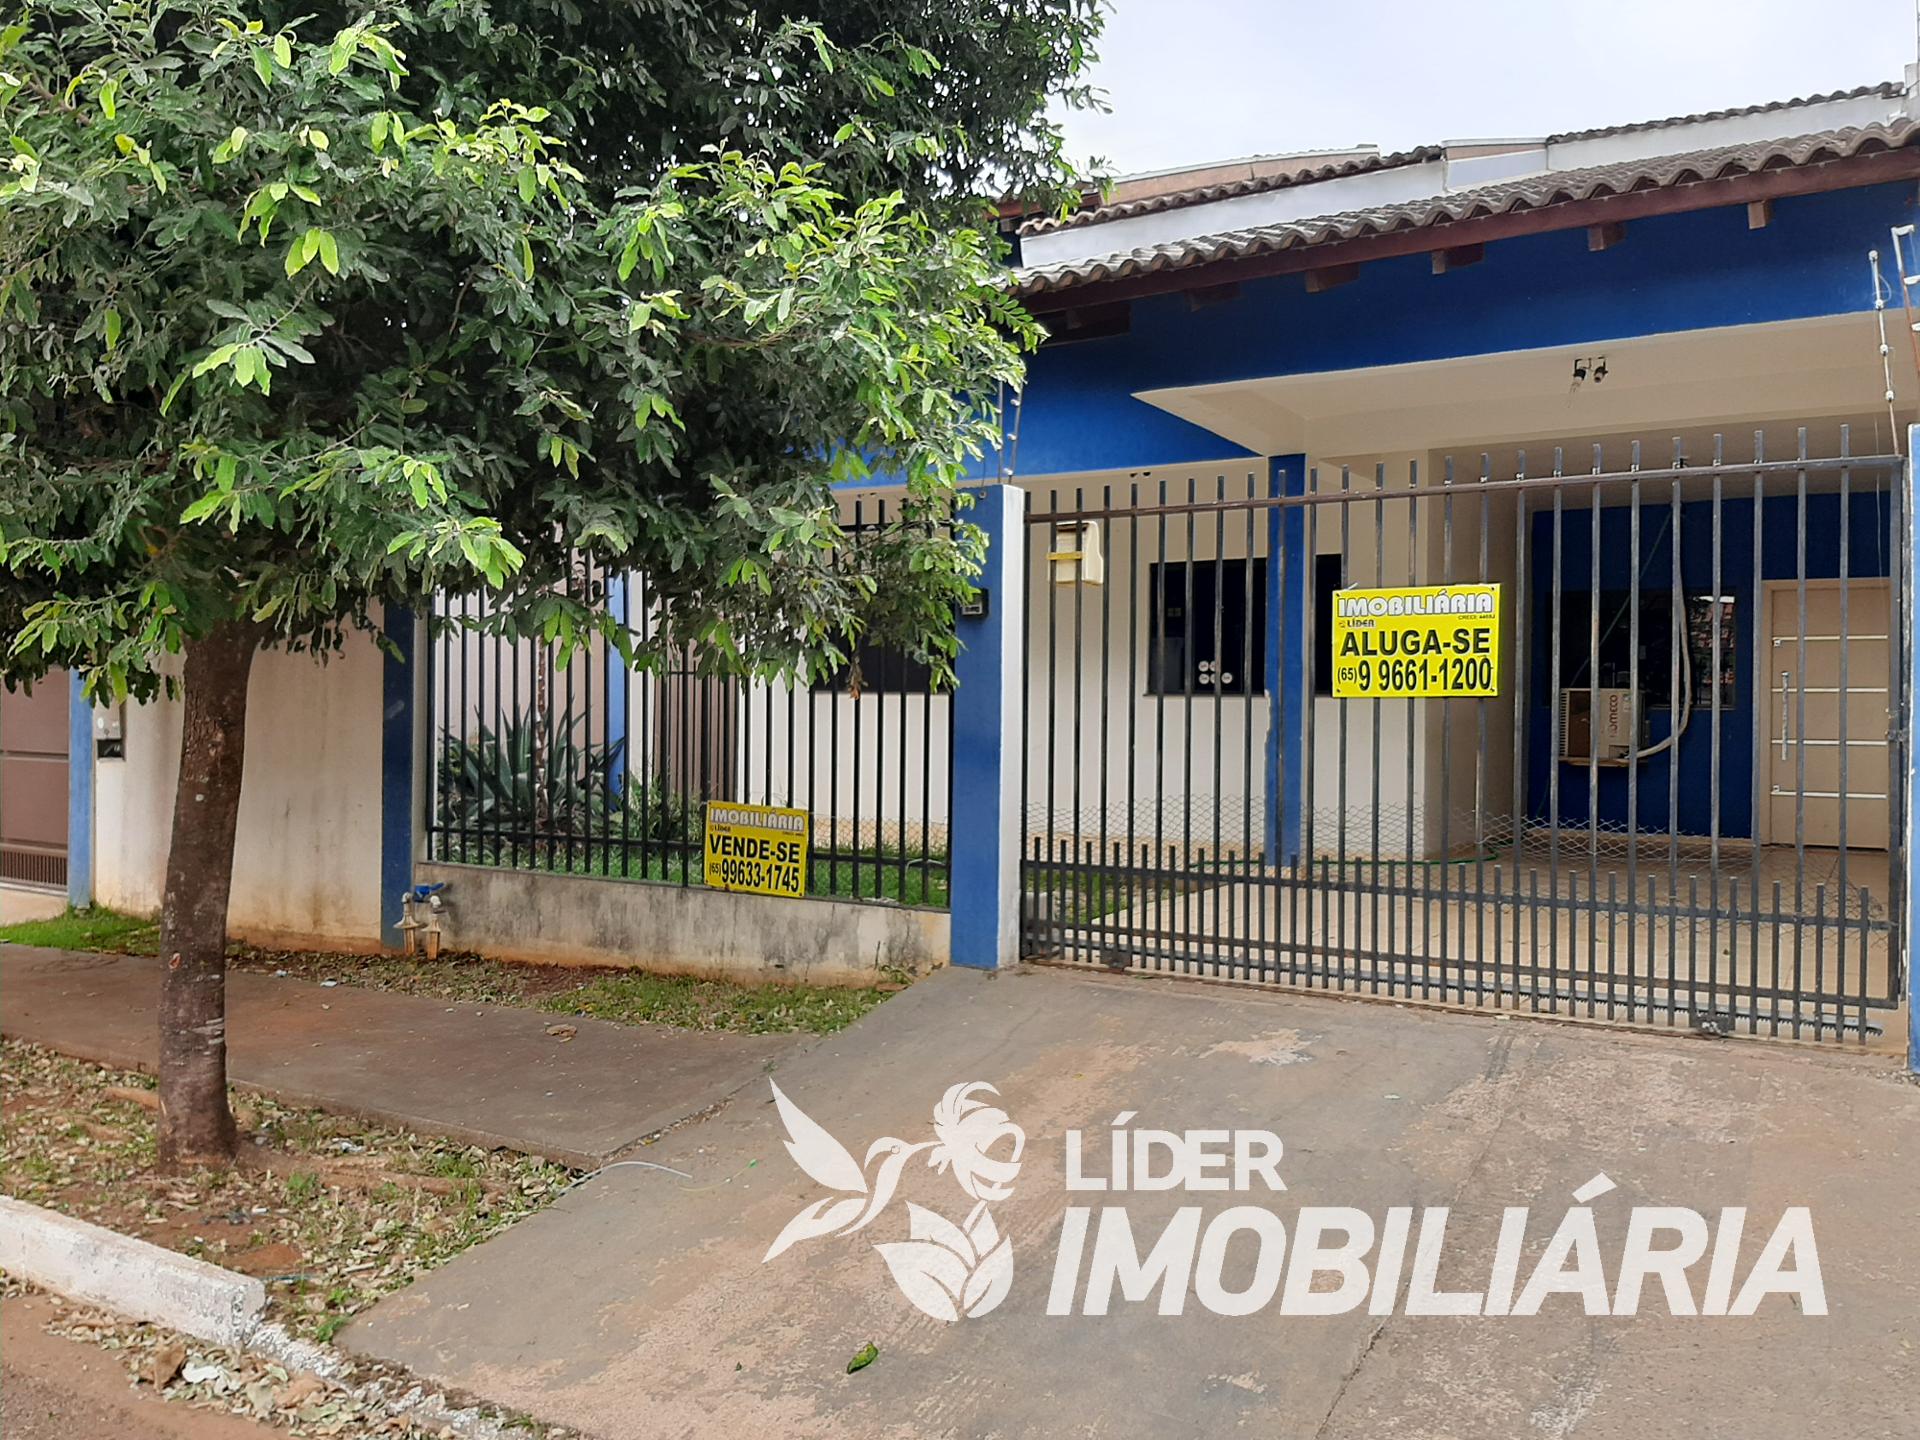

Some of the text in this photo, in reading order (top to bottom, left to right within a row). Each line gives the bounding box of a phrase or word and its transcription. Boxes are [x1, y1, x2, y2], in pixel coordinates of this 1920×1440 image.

[1337, 589, 1493, 618] IMOBILIÁRIA
[1347, 619, 1375, 628] LÍDER
[1340, 628, 1491, 657] ALUGA-SE
[1378, 657, 1492, 691] 9661-1200
[710, 807, 805, 832] IMOBILIÁRIA
[709, 833, 801, 864] VENDE-SE
[721, 858, 800, 892] 99633-1745
